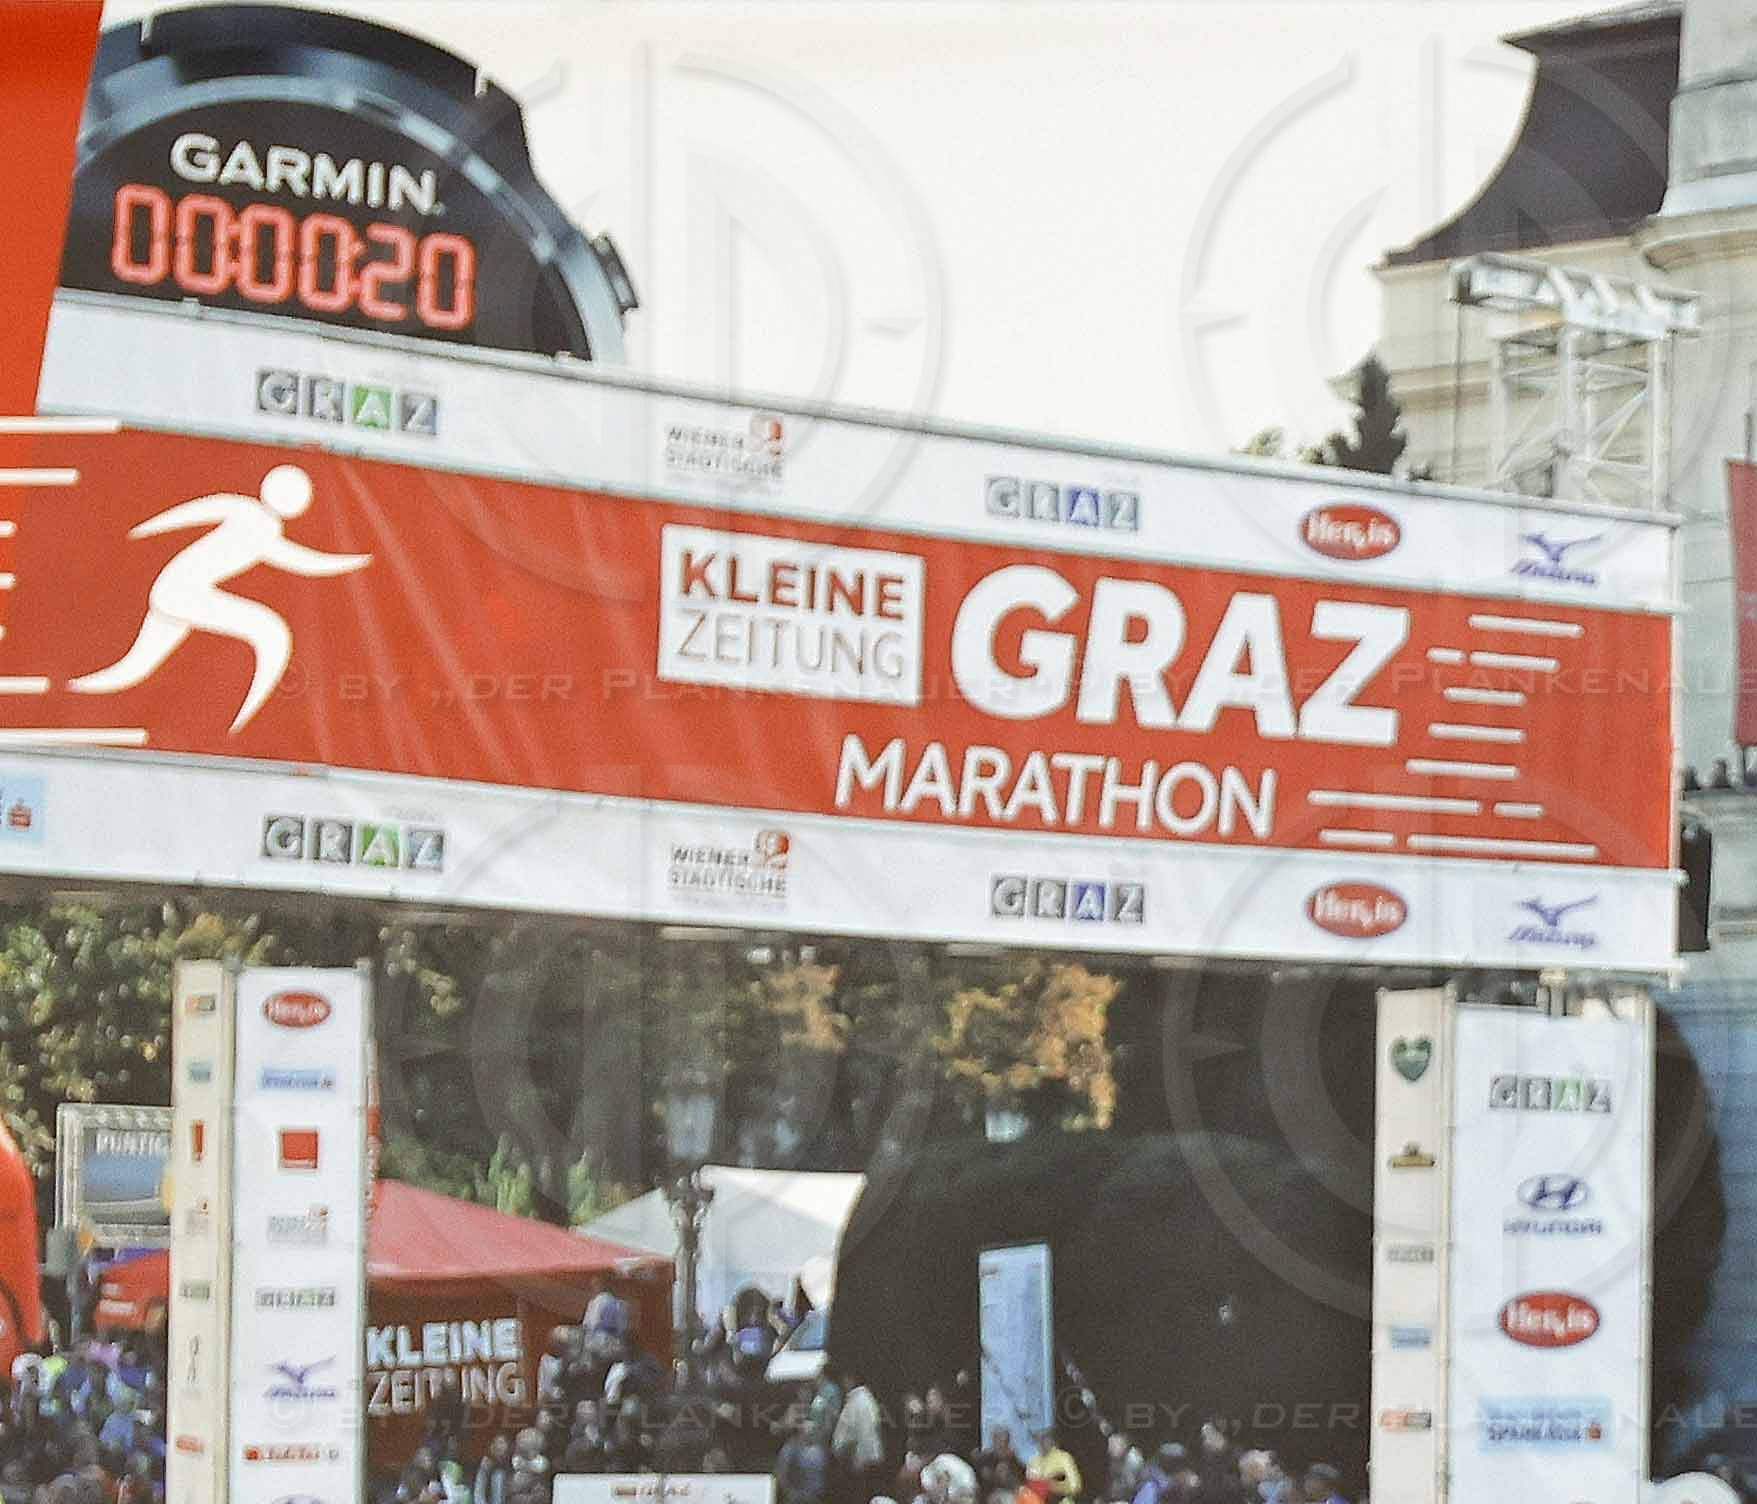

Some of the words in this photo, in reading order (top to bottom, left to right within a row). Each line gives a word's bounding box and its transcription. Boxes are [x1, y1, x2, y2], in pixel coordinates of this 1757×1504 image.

[170, 133, 438, 215] GARMIN
[256, 370, 438, 437] GRAZ
[984, 475, 1140, 532] GRAZ
[681, 550, 906, 621] KLEINE
[677, 607, 905, 680] ZEITUNG
[952, 563, 1411, 748] GRAZ
[836, 730, 1278, 841] MARATHON
[262, 813, 447, 873] GRAZ
[991, 874, 1146, 925] GRAZ
[366, 1318, 523, 1370] KLEINE
